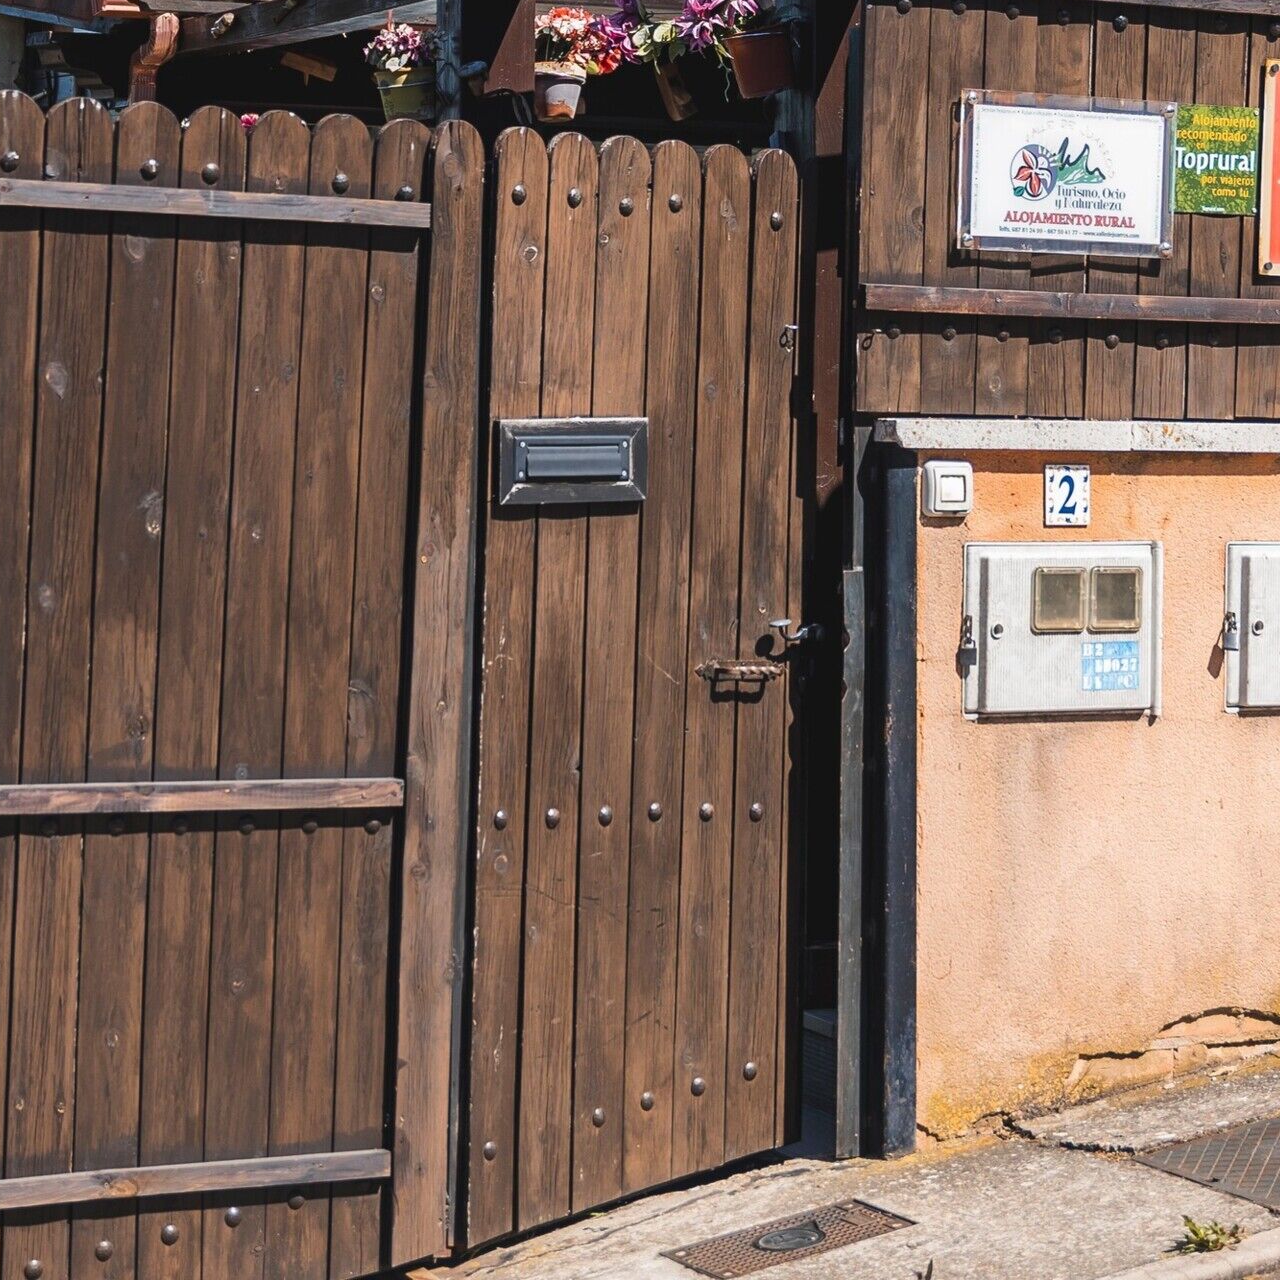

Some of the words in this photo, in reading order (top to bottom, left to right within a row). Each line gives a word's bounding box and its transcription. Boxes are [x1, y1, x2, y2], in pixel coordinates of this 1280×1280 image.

[1192, 114, 1255, 128] Alojamiento
[1176, 129, 1247, 142] recomendado
[1196, 142, 1206, 150] en
[1175, 147, 1255, 174] Toprural
[1201, 175, 1217, 186] por
[1220, 176, 1254, 186] viajeros
[1057, 185, 1100, 199] Turismo,
[1102, 188, 1126, 200] Ocio
[1212, 188, 1236, 197] como
[1055, 199, 1061, 210] y
[1064, 198, 1122, 211] Naturaleza
[1004, 211, 1093, 227] ALOJAMIENTO
[1094, 215, 1136, 229] RURAL
[1058, 475, 1077, 515] 2
